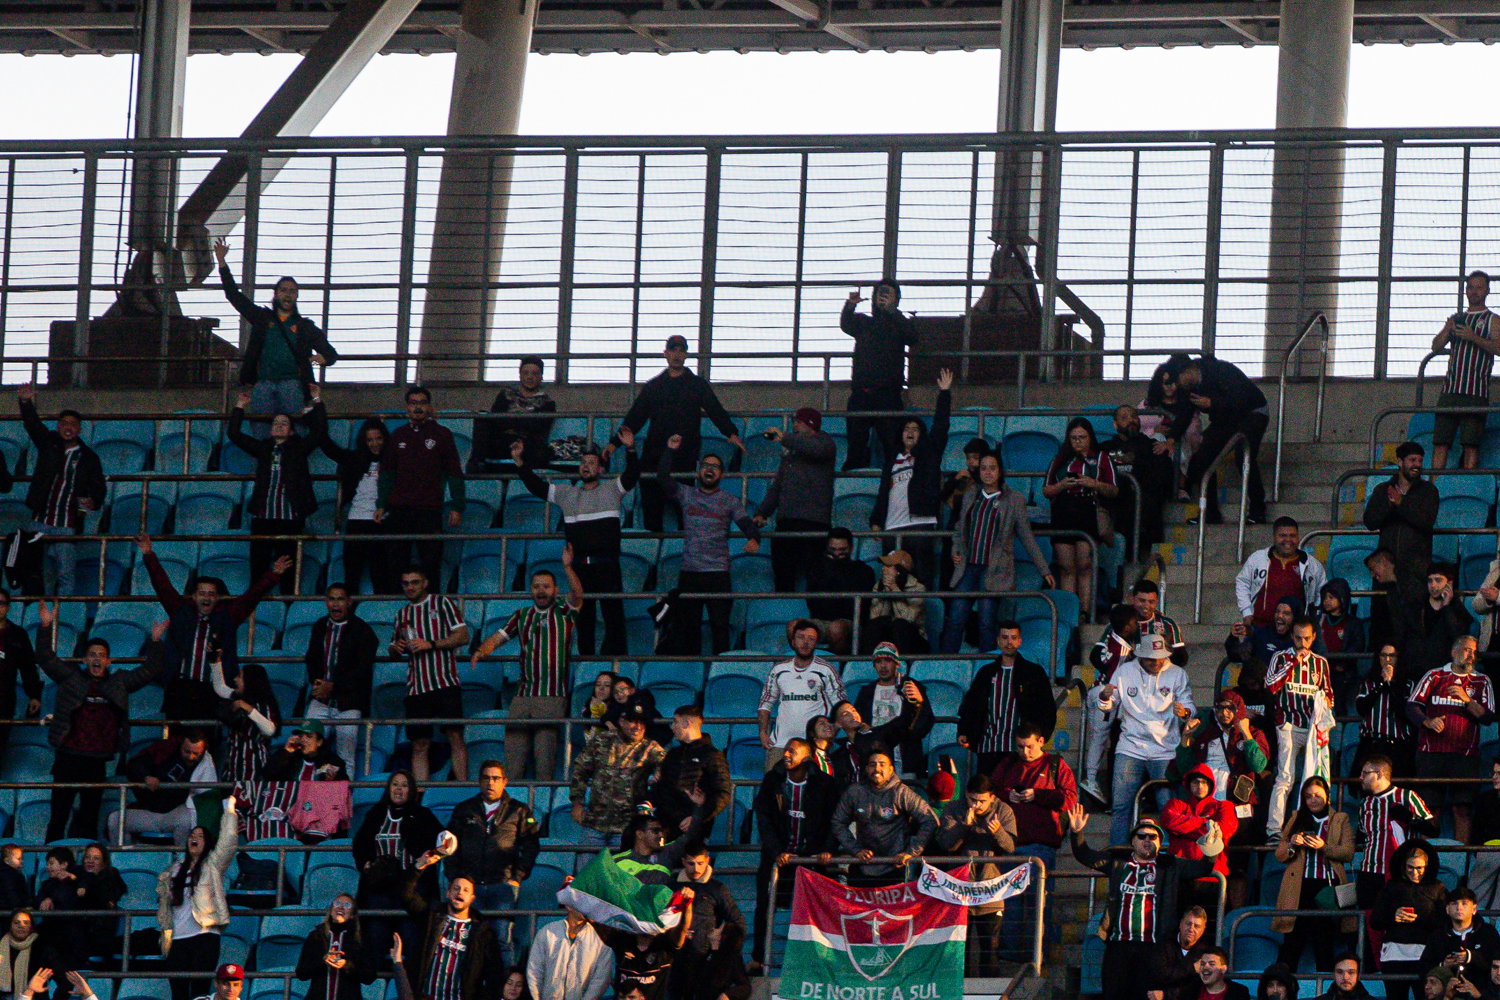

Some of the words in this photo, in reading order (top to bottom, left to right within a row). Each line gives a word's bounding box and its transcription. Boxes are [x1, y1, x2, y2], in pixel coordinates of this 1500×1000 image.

[1432, 696, 1465, 707] Unim
[800, 980, 823, 1000] DE
[909, 981, 942, 1000] SUL
